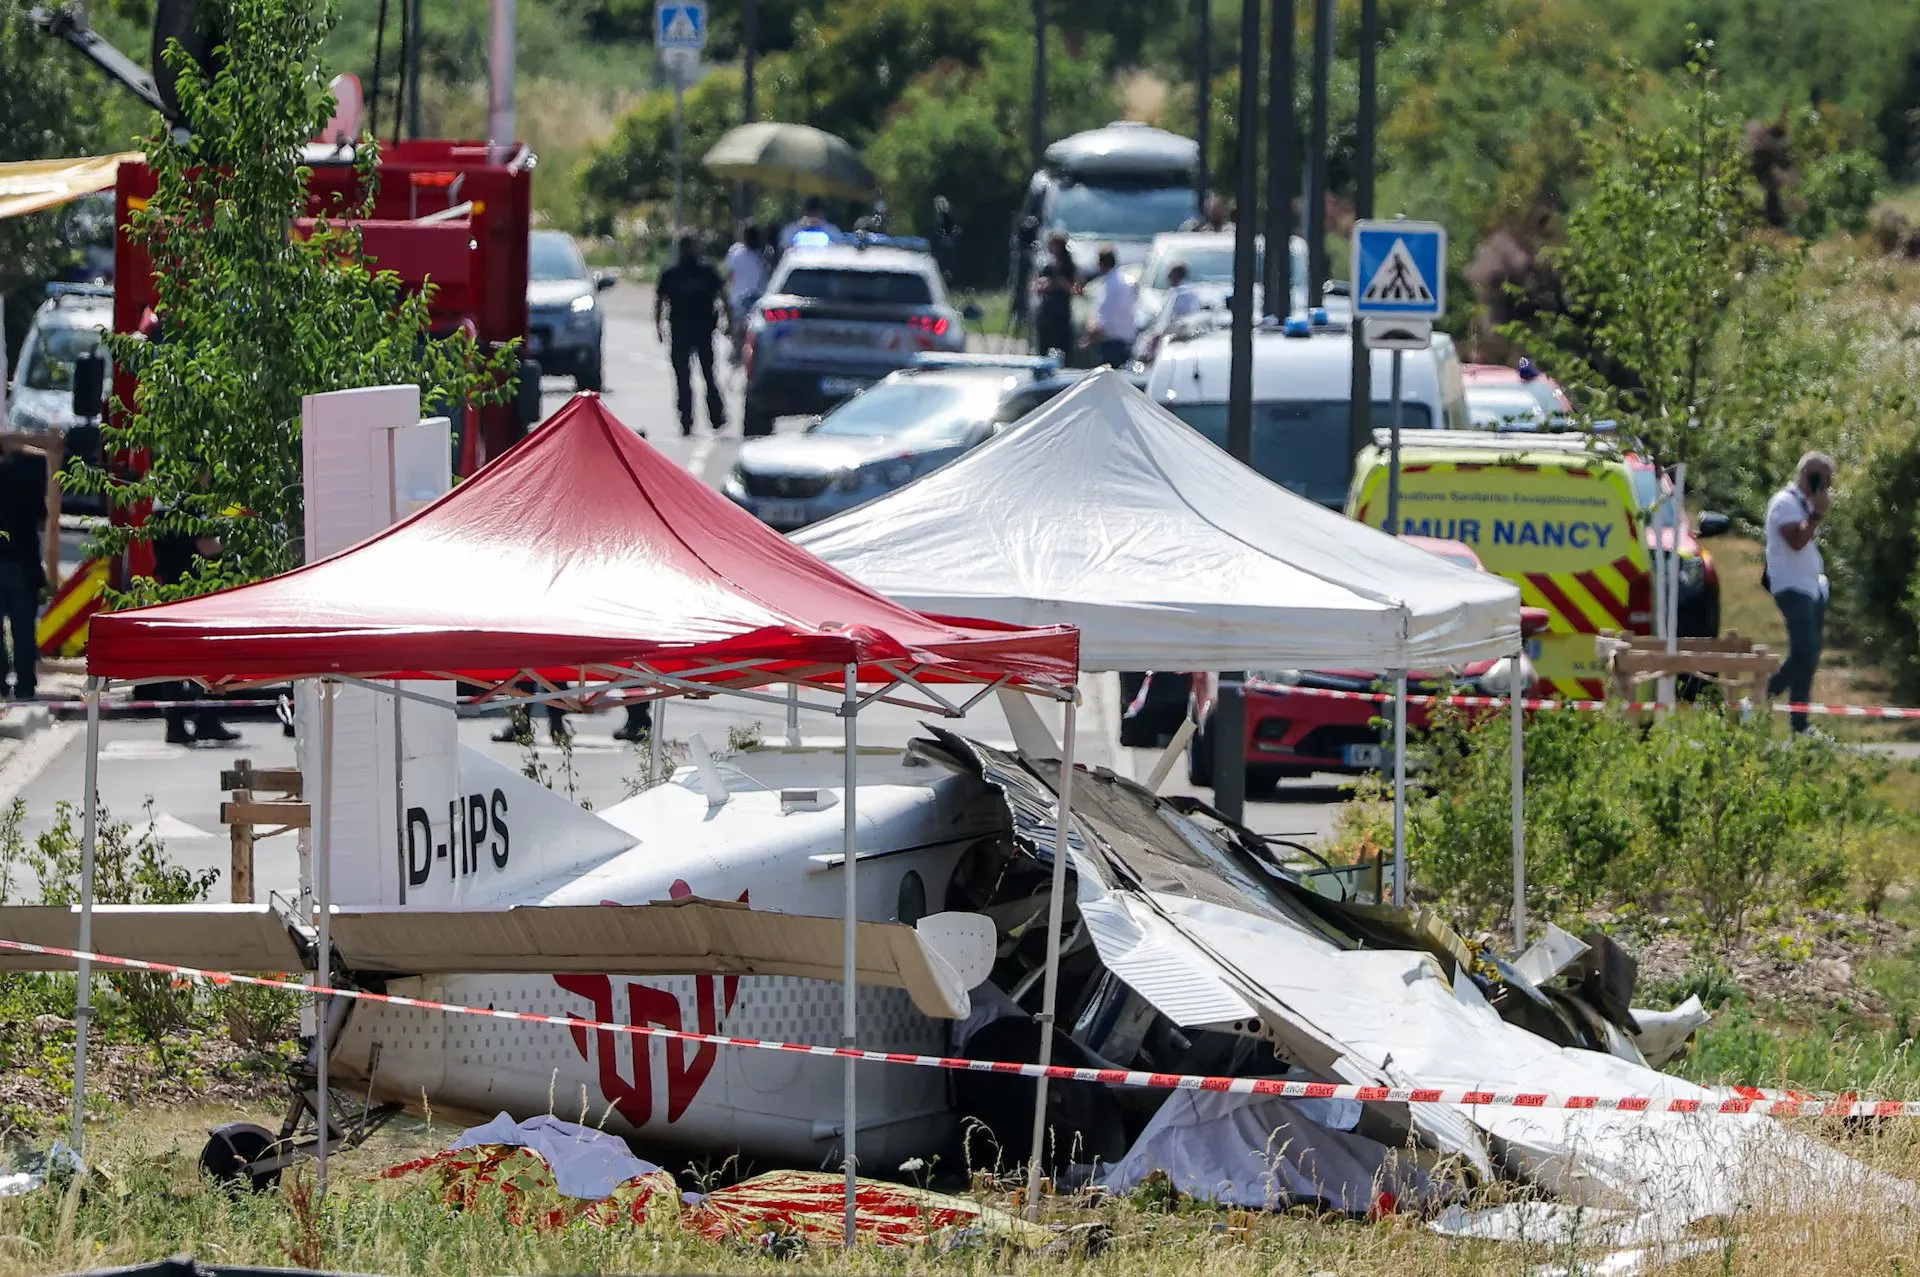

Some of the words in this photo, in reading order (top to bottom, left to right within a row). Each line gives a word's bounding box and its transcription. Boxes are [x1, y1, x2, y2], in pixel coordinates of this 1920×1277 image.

[1382, 518, 1480, 545] MUR
[1493, 519, 1614, 549] NANCY
[1168, 1077, 1200, 1088] POMPERS
[1272, 1083, 1304, 1094] POMPERS
[1377, 1089, 1409, 1099] POMPERS
